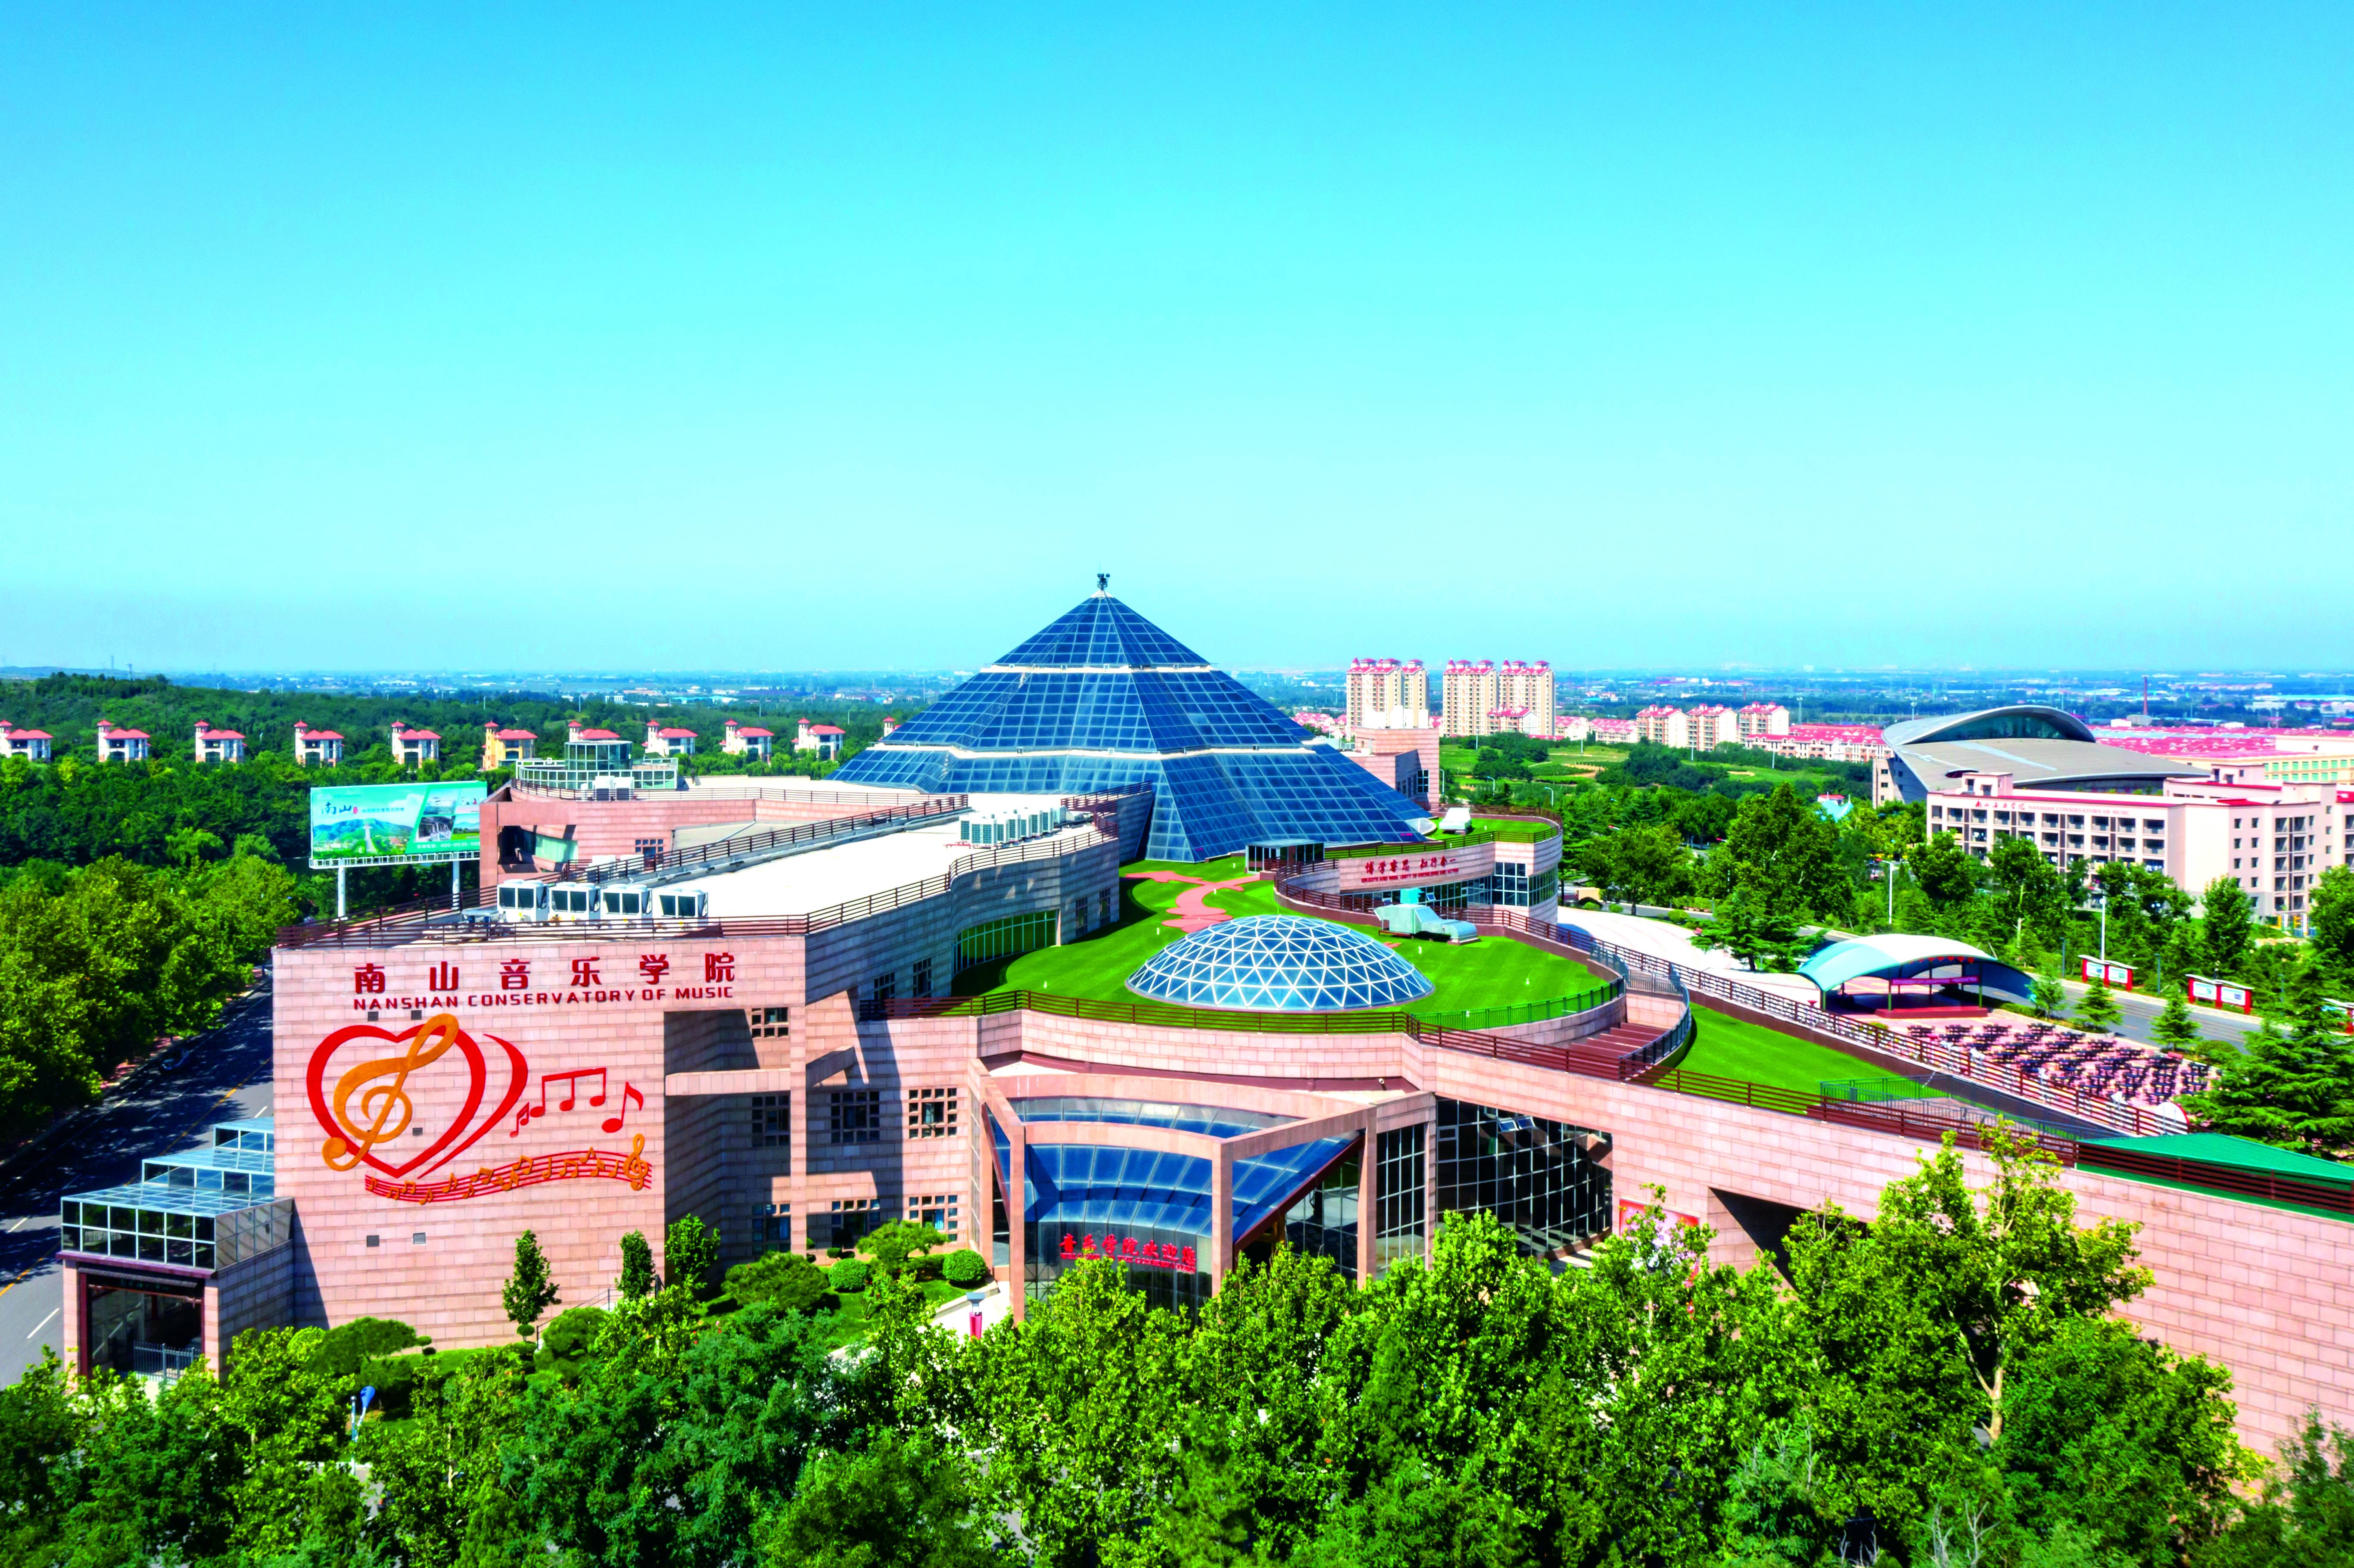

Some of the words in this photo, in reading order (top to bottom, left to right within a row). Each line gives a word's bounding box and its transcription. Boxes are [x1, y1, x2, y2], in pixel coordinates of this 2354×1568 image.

[322, 802, 352, 815] 南山
[355, 952, 735, 994] 南山音乐学院
[354, 996, 458, 1010] NANSHAN
[468, 990, 635, 1007] CONSERVATORY
[642, 989, 666, 1001] OF
[675, 986, 733, 1000] MUSIC
